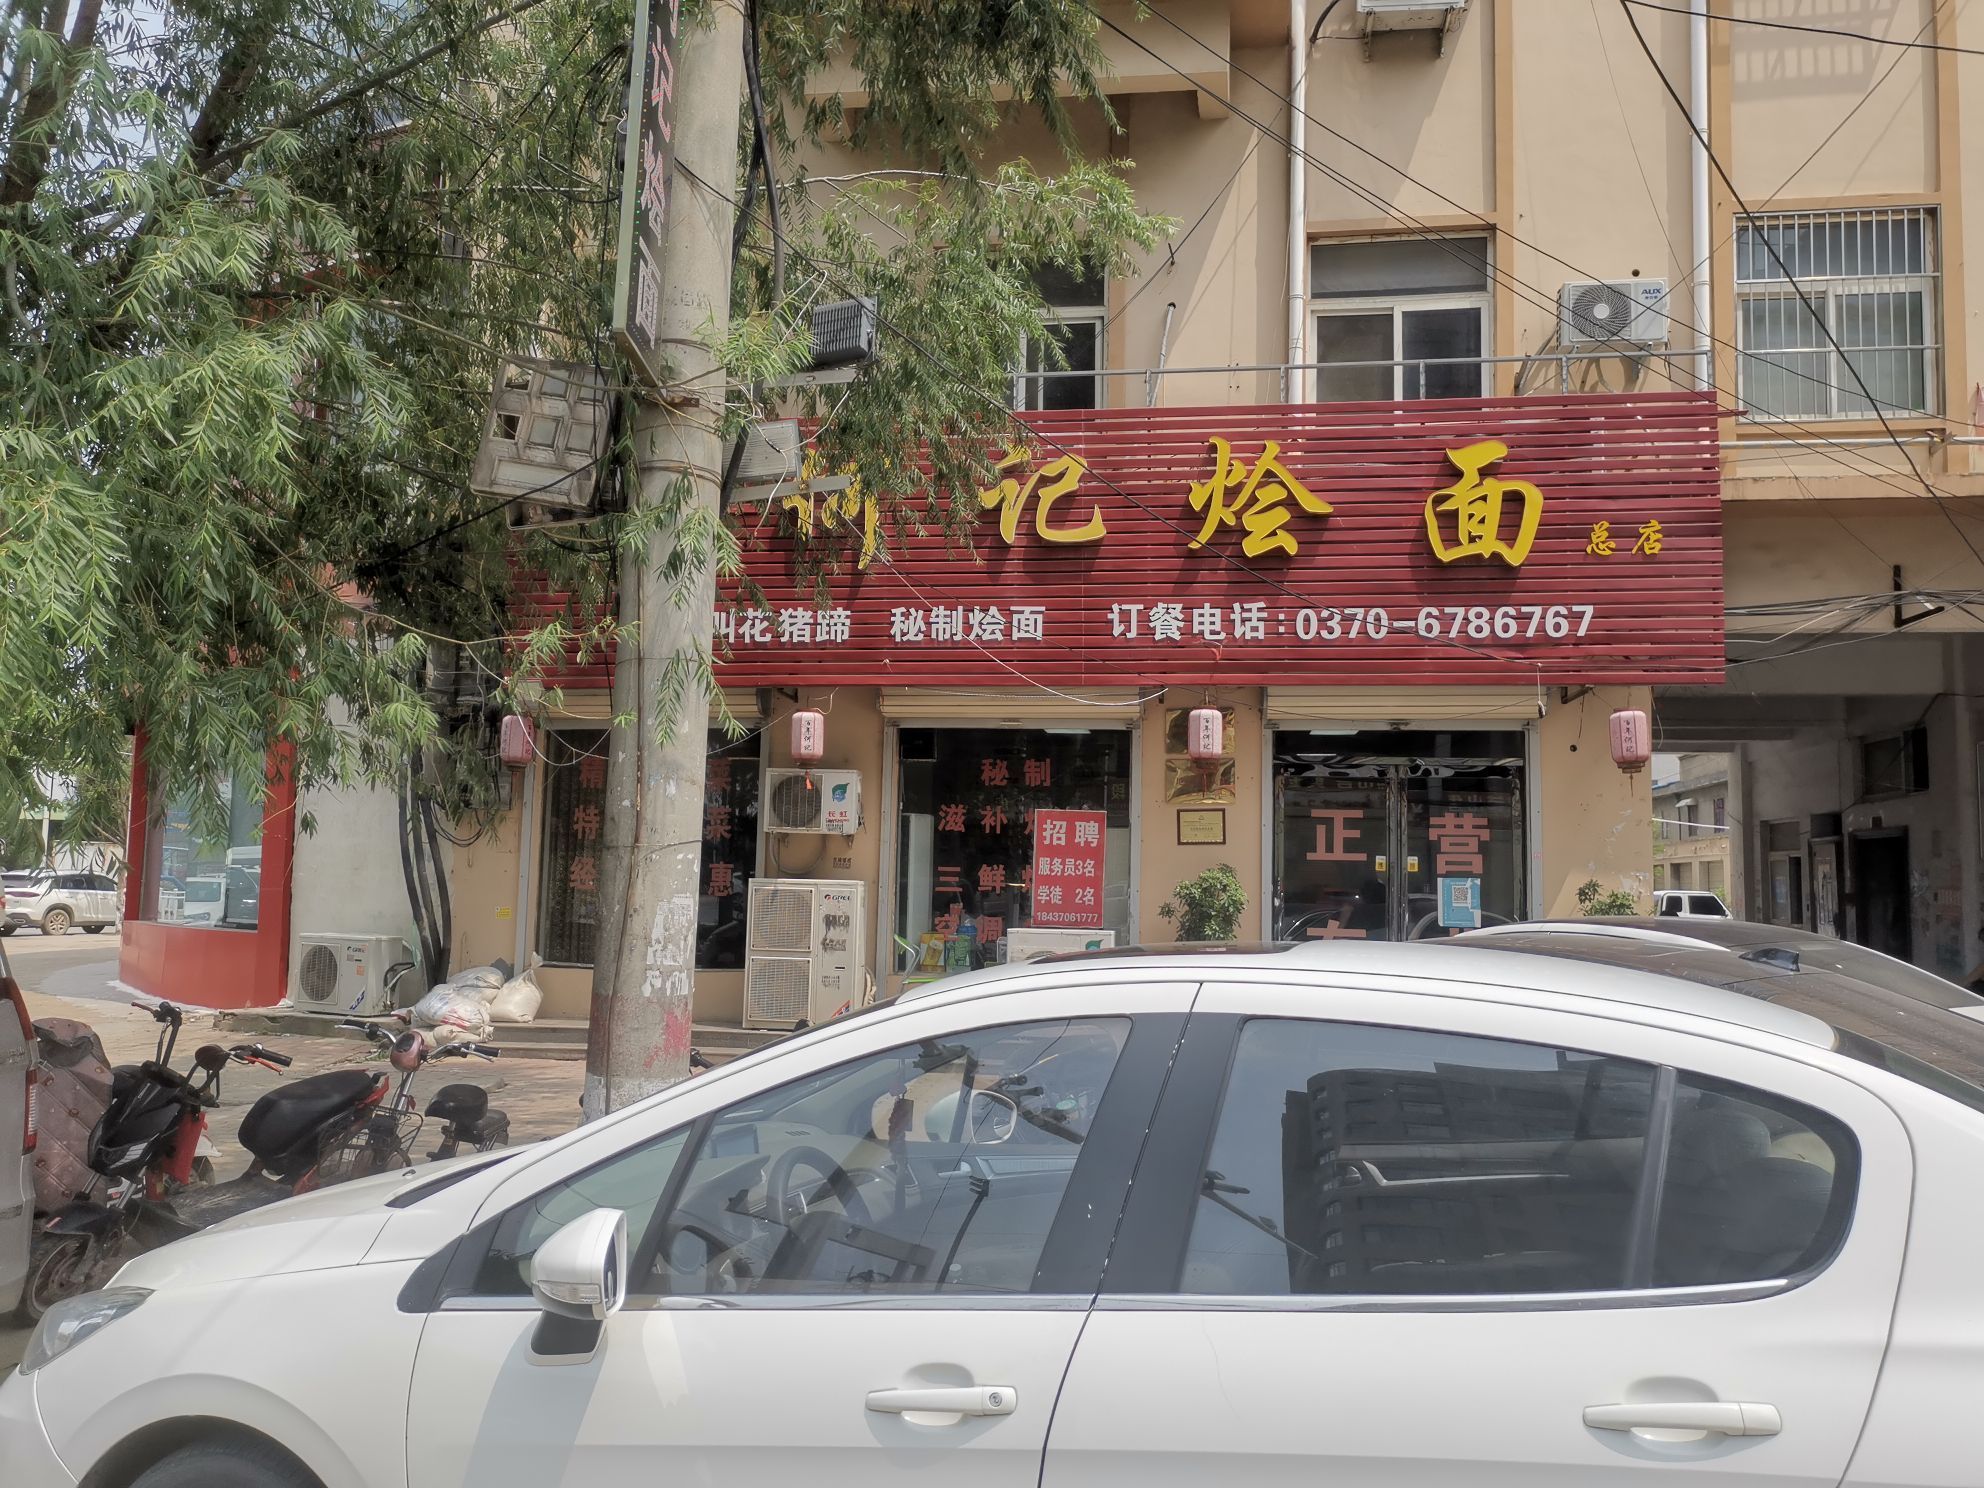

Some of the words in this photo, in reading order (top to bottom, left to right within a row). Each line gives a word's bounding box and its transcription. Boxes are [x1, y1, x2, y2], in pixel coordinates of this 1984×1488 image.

[1586, 520, 1664, 556] 总店
[890, 606, 1046, 641] 秘制烩面
[980, 758, 1051, 787] 秘制
[1042, 819, 1100, 848] 招聘
[1038, 857, 1096, 877] 服务员3名
[1037, 885, 1063, 905] 学徒
[1075, 886, 1095, 906] 2名
[1036, 911, 1098, 922] 18437061777
